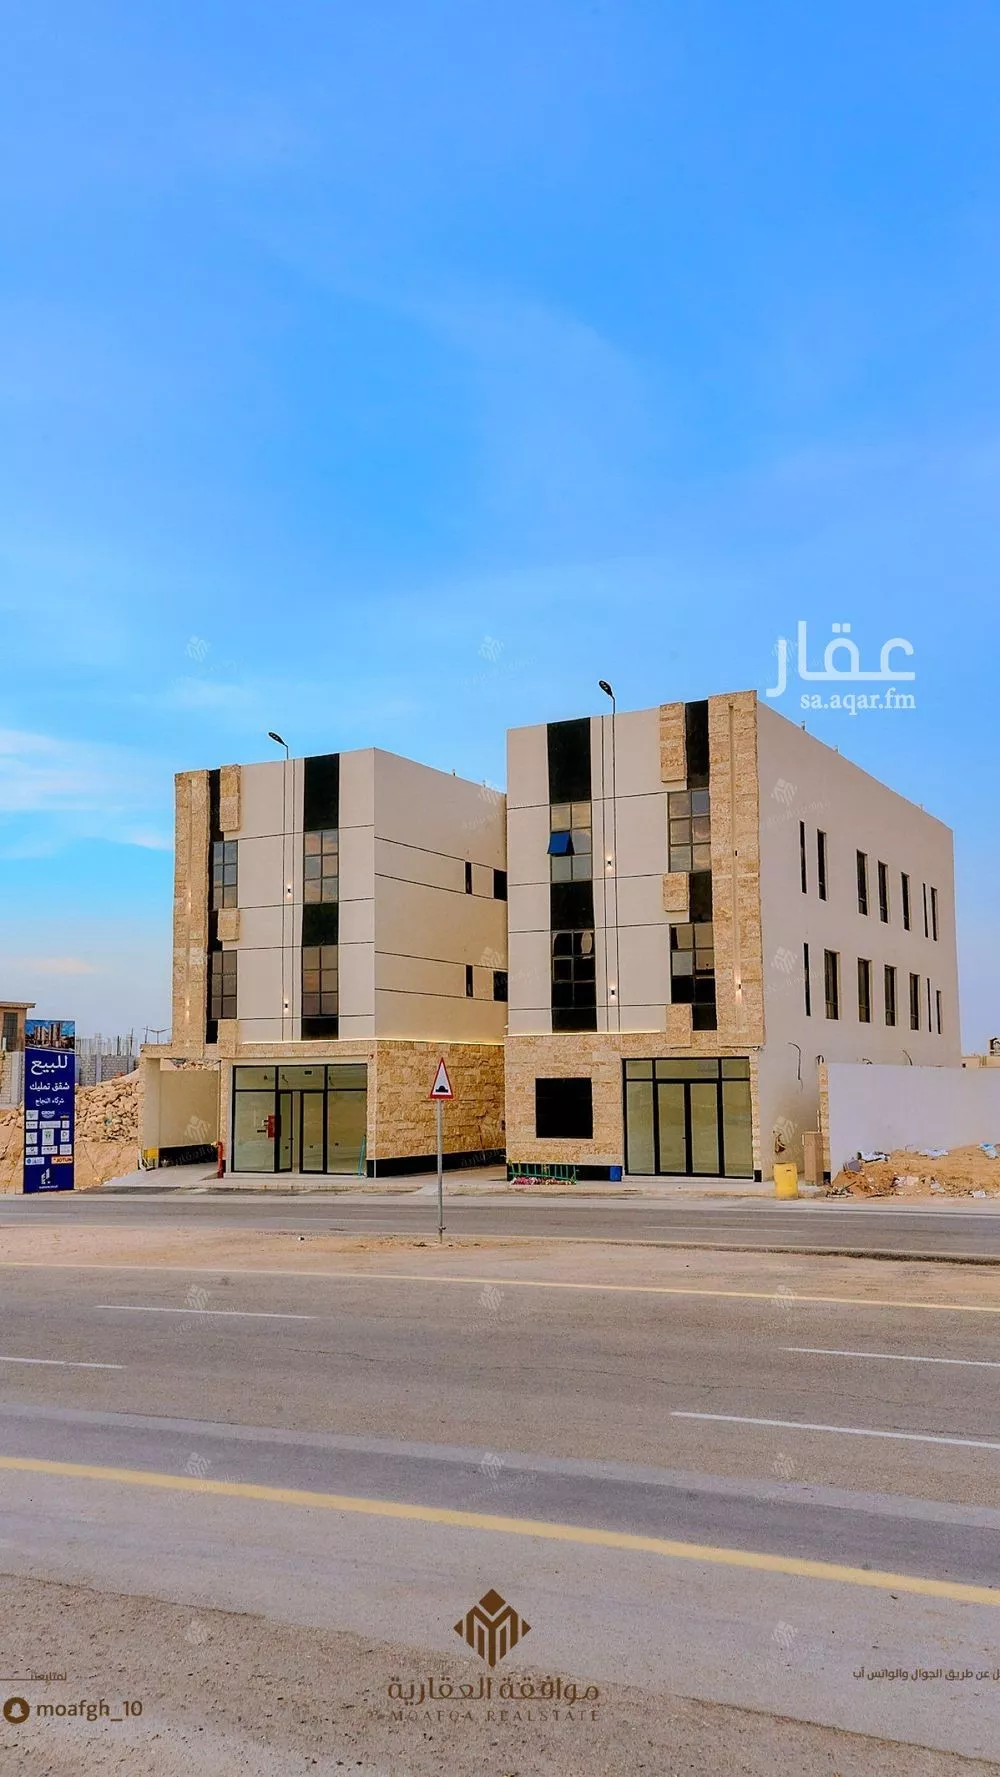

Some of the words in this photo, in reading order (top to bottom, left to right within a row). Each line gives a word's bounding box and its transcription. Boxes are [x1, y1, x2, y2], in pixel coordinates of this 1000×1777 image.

[31, 1055, 68, 1075] للبيع
[30, 1081, 50, 1091] تمليك
[52, 1082, 70, 1091] شقق
